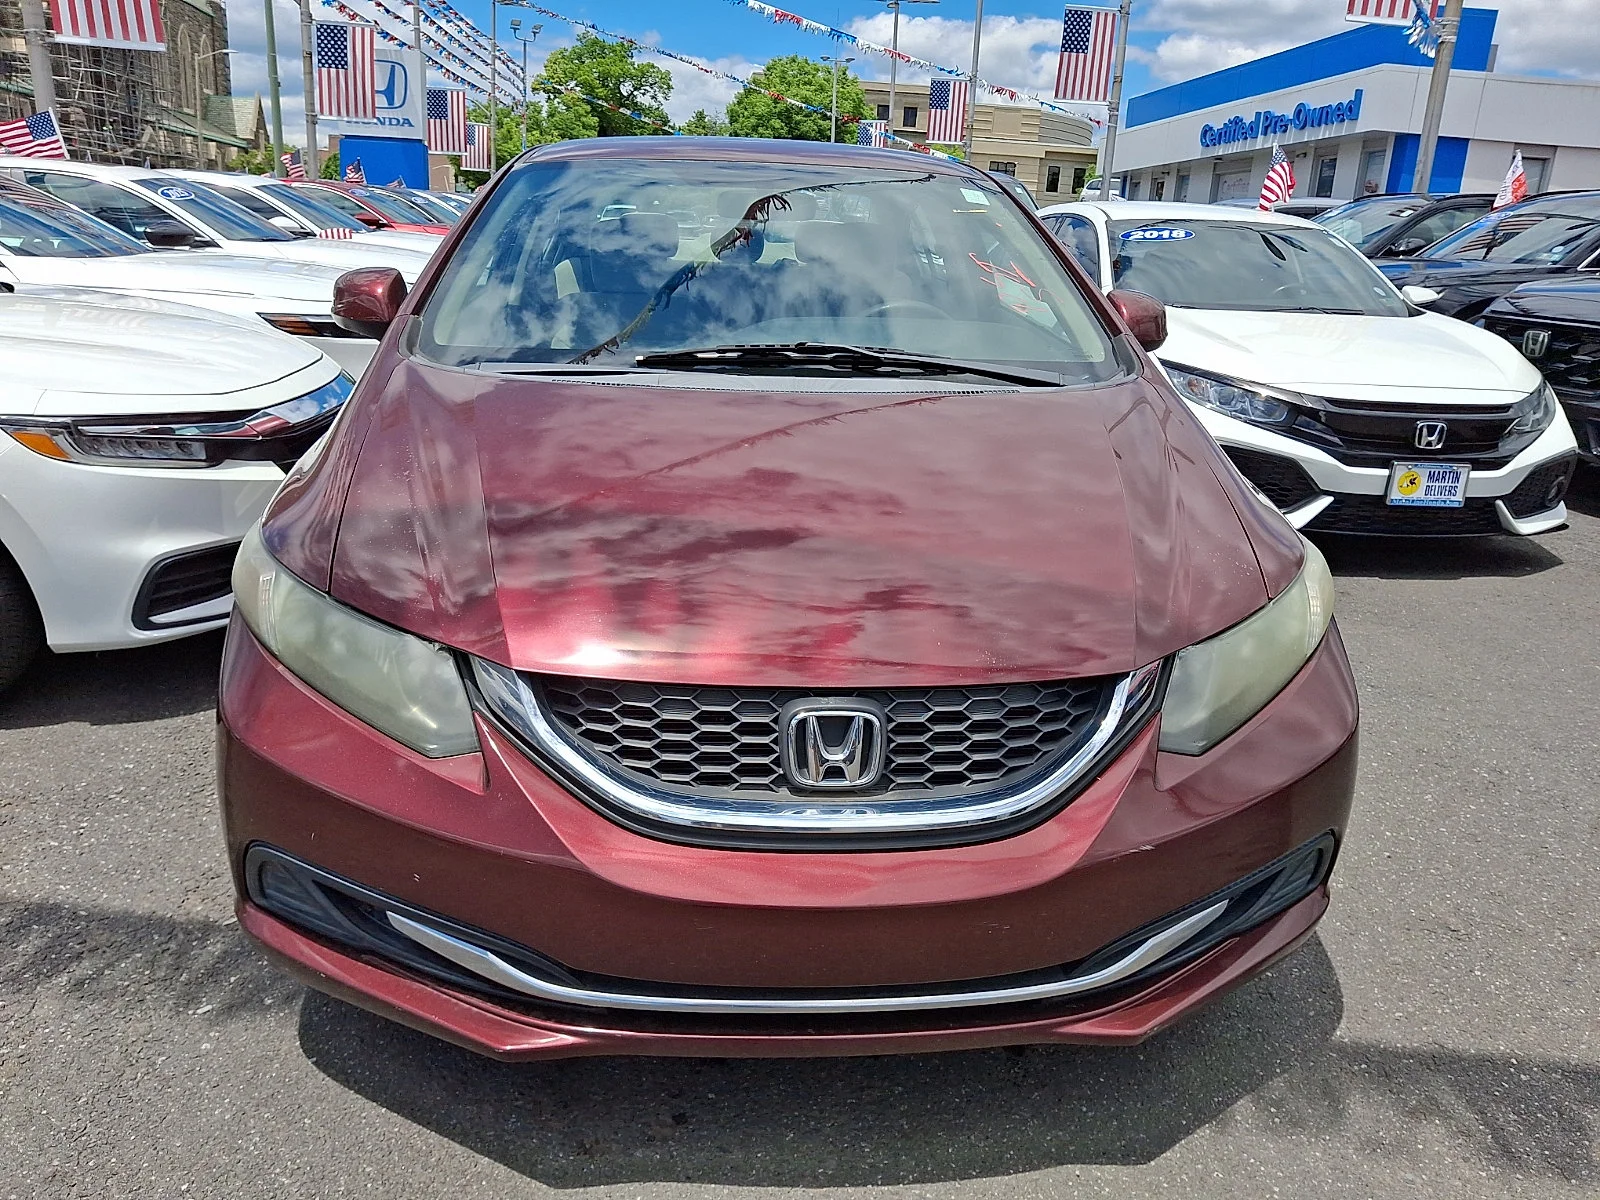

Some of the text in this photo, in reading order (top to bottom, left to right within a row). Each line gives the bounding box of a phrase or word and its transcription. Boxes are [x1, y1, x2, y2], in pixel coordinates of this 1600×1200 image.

[345, 116, 415, 128] NDA
[1200, 88, 1364, 147] Certified Pre-Owned
[1128, 229, 1187, 241] 2018
[1427, 470, 1462, 484] MARTIN
[1424, 484, 1459, 497] DELIVERS
